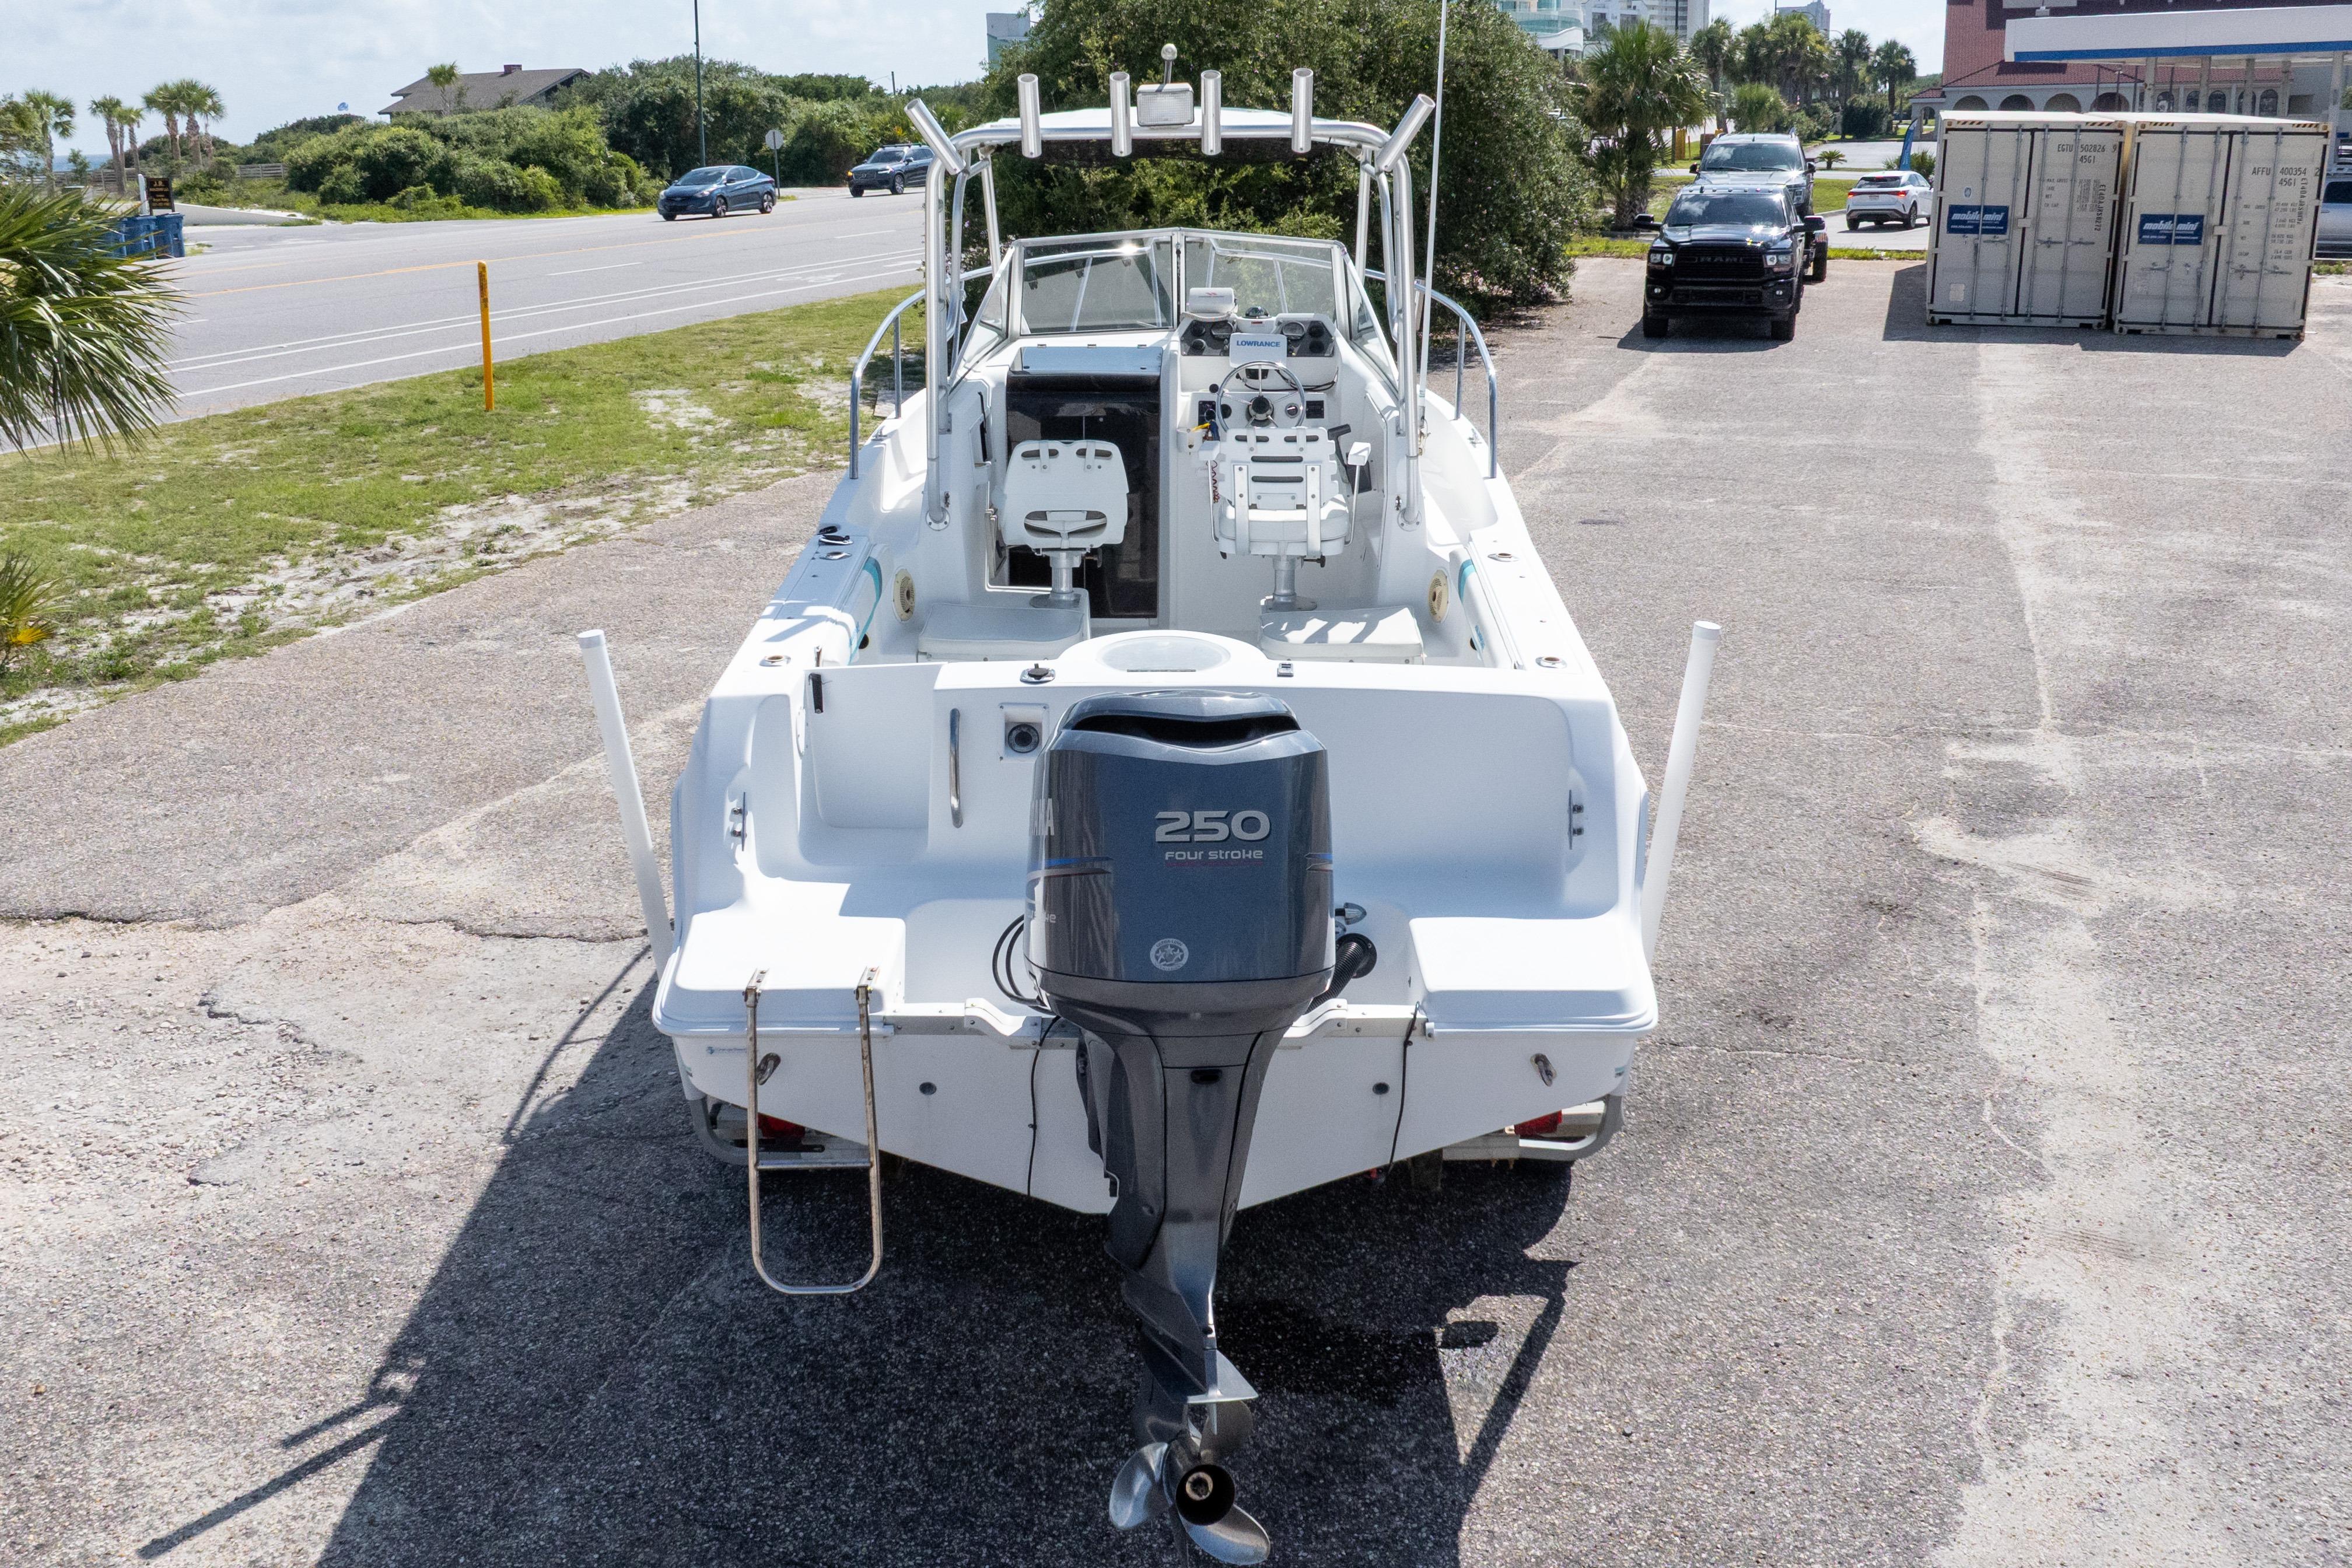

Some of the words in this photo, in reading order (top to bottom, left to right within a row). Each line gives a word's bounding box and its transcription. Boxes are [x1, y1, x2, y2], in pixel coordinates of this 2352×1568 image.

[2057, 144, 2074, 152] EGTU
[2112, 145, 2117, 153] 9
[2080, 155, 2095, 163] 45G1
[2252, 167, 2271, 176] AFFU
[2280, 167, 2307, 176] 400354
[2278, 177, 2297, 187] 45G1
[1155, 810, 1271, 842] 250
